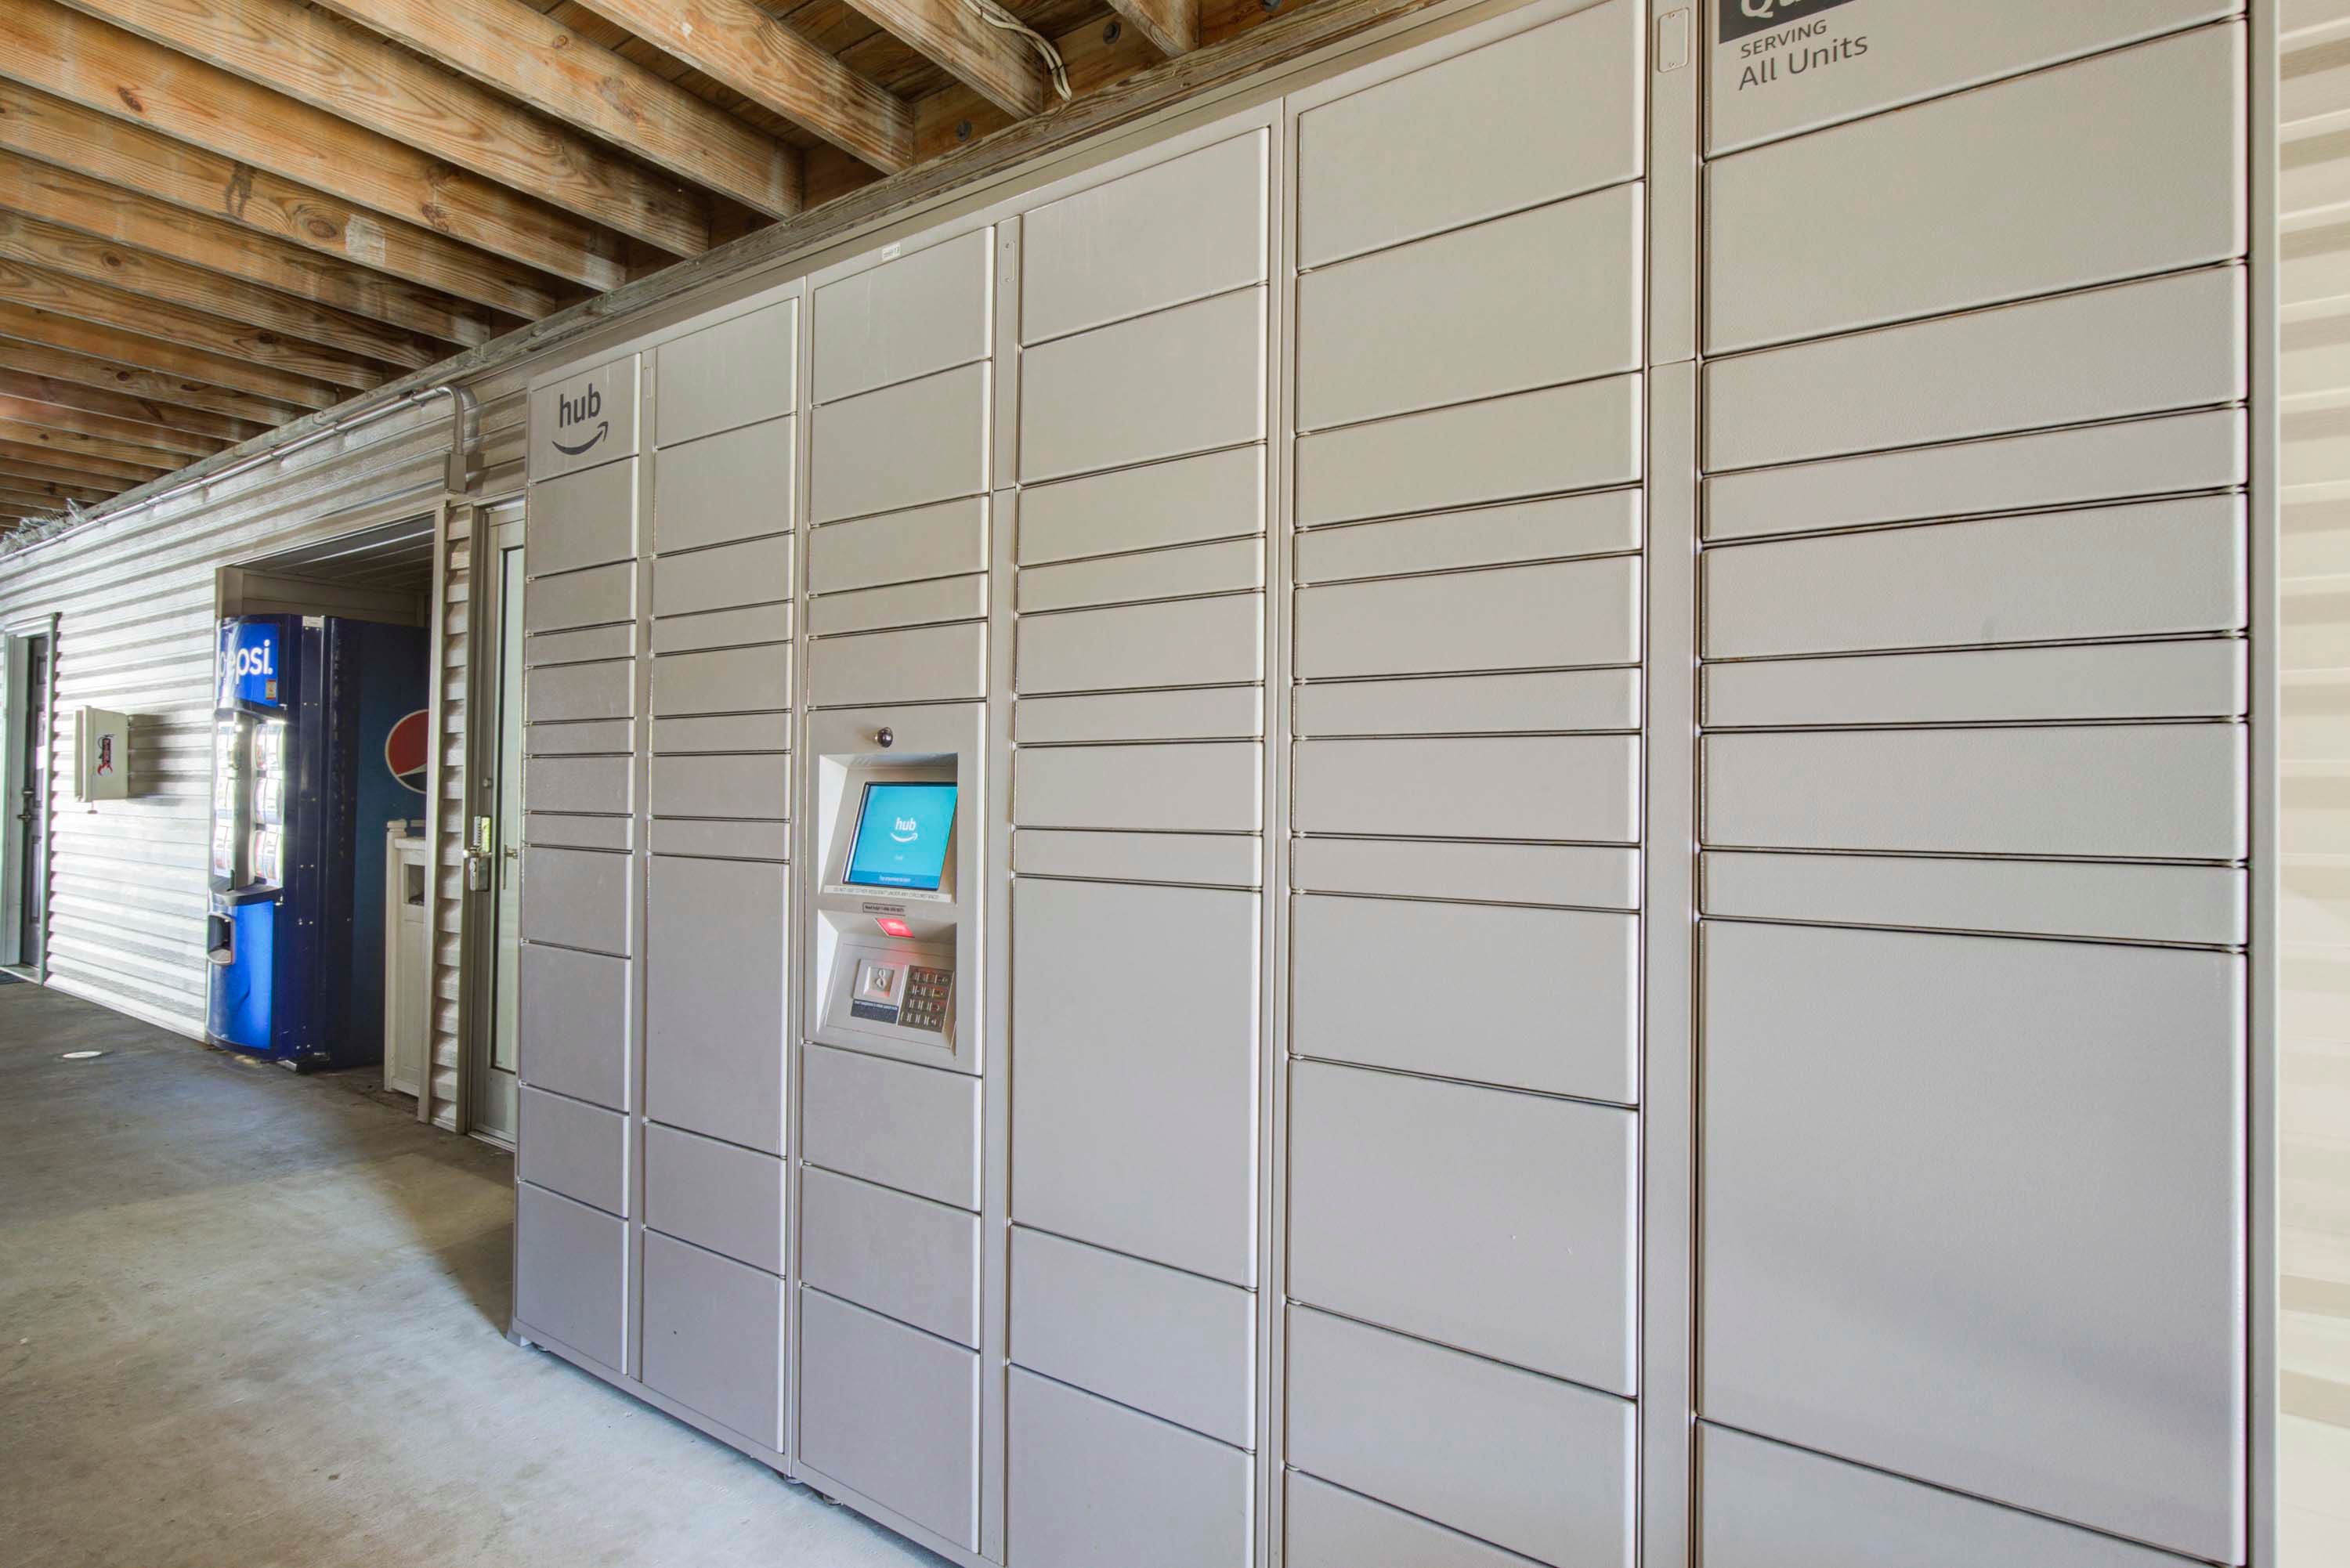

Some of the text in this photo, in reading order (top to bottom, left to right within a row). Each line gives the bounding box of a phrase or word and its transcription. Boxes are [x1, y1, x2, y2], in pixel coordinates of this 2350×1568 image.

[1741, 19, 1827, 59] SERVING
[1738, 36, 1868, 91] All Units
[559, 382, 601, 428] hub
[895, 817, 916, 831] hub
